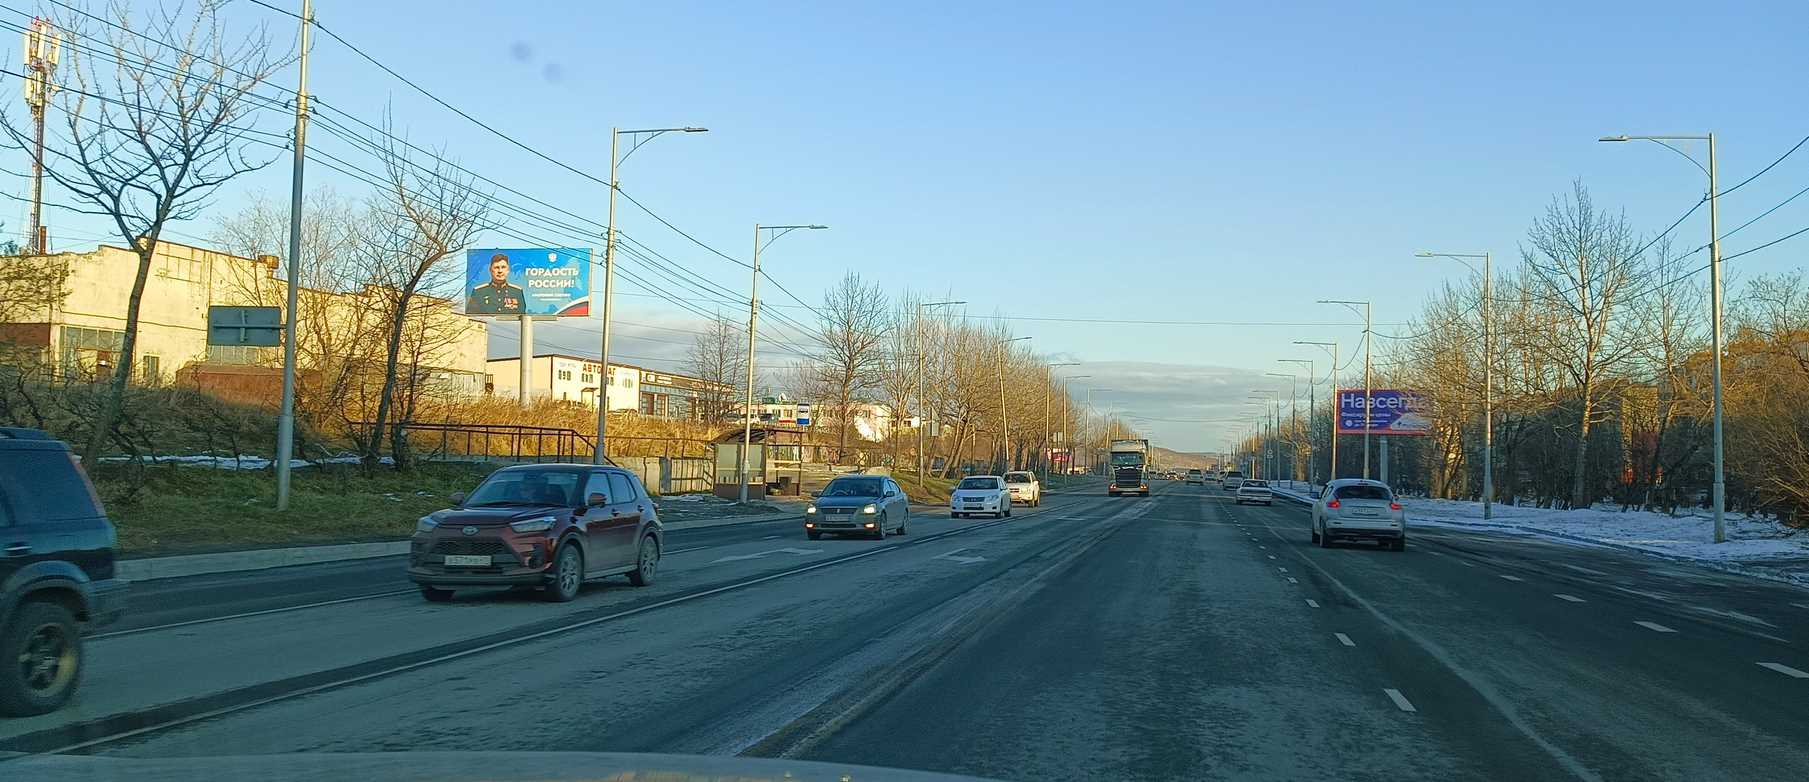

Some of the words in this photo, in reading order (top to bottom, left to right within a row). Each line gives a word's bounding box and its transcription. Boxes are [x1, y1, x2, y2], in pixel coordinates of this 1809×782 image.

[526, 267, 579, 277] ГОРДОСТЬ
[528, 279, 575, 288] РОССИИ!
[582, 363, 616, 376] АВТОАГ
